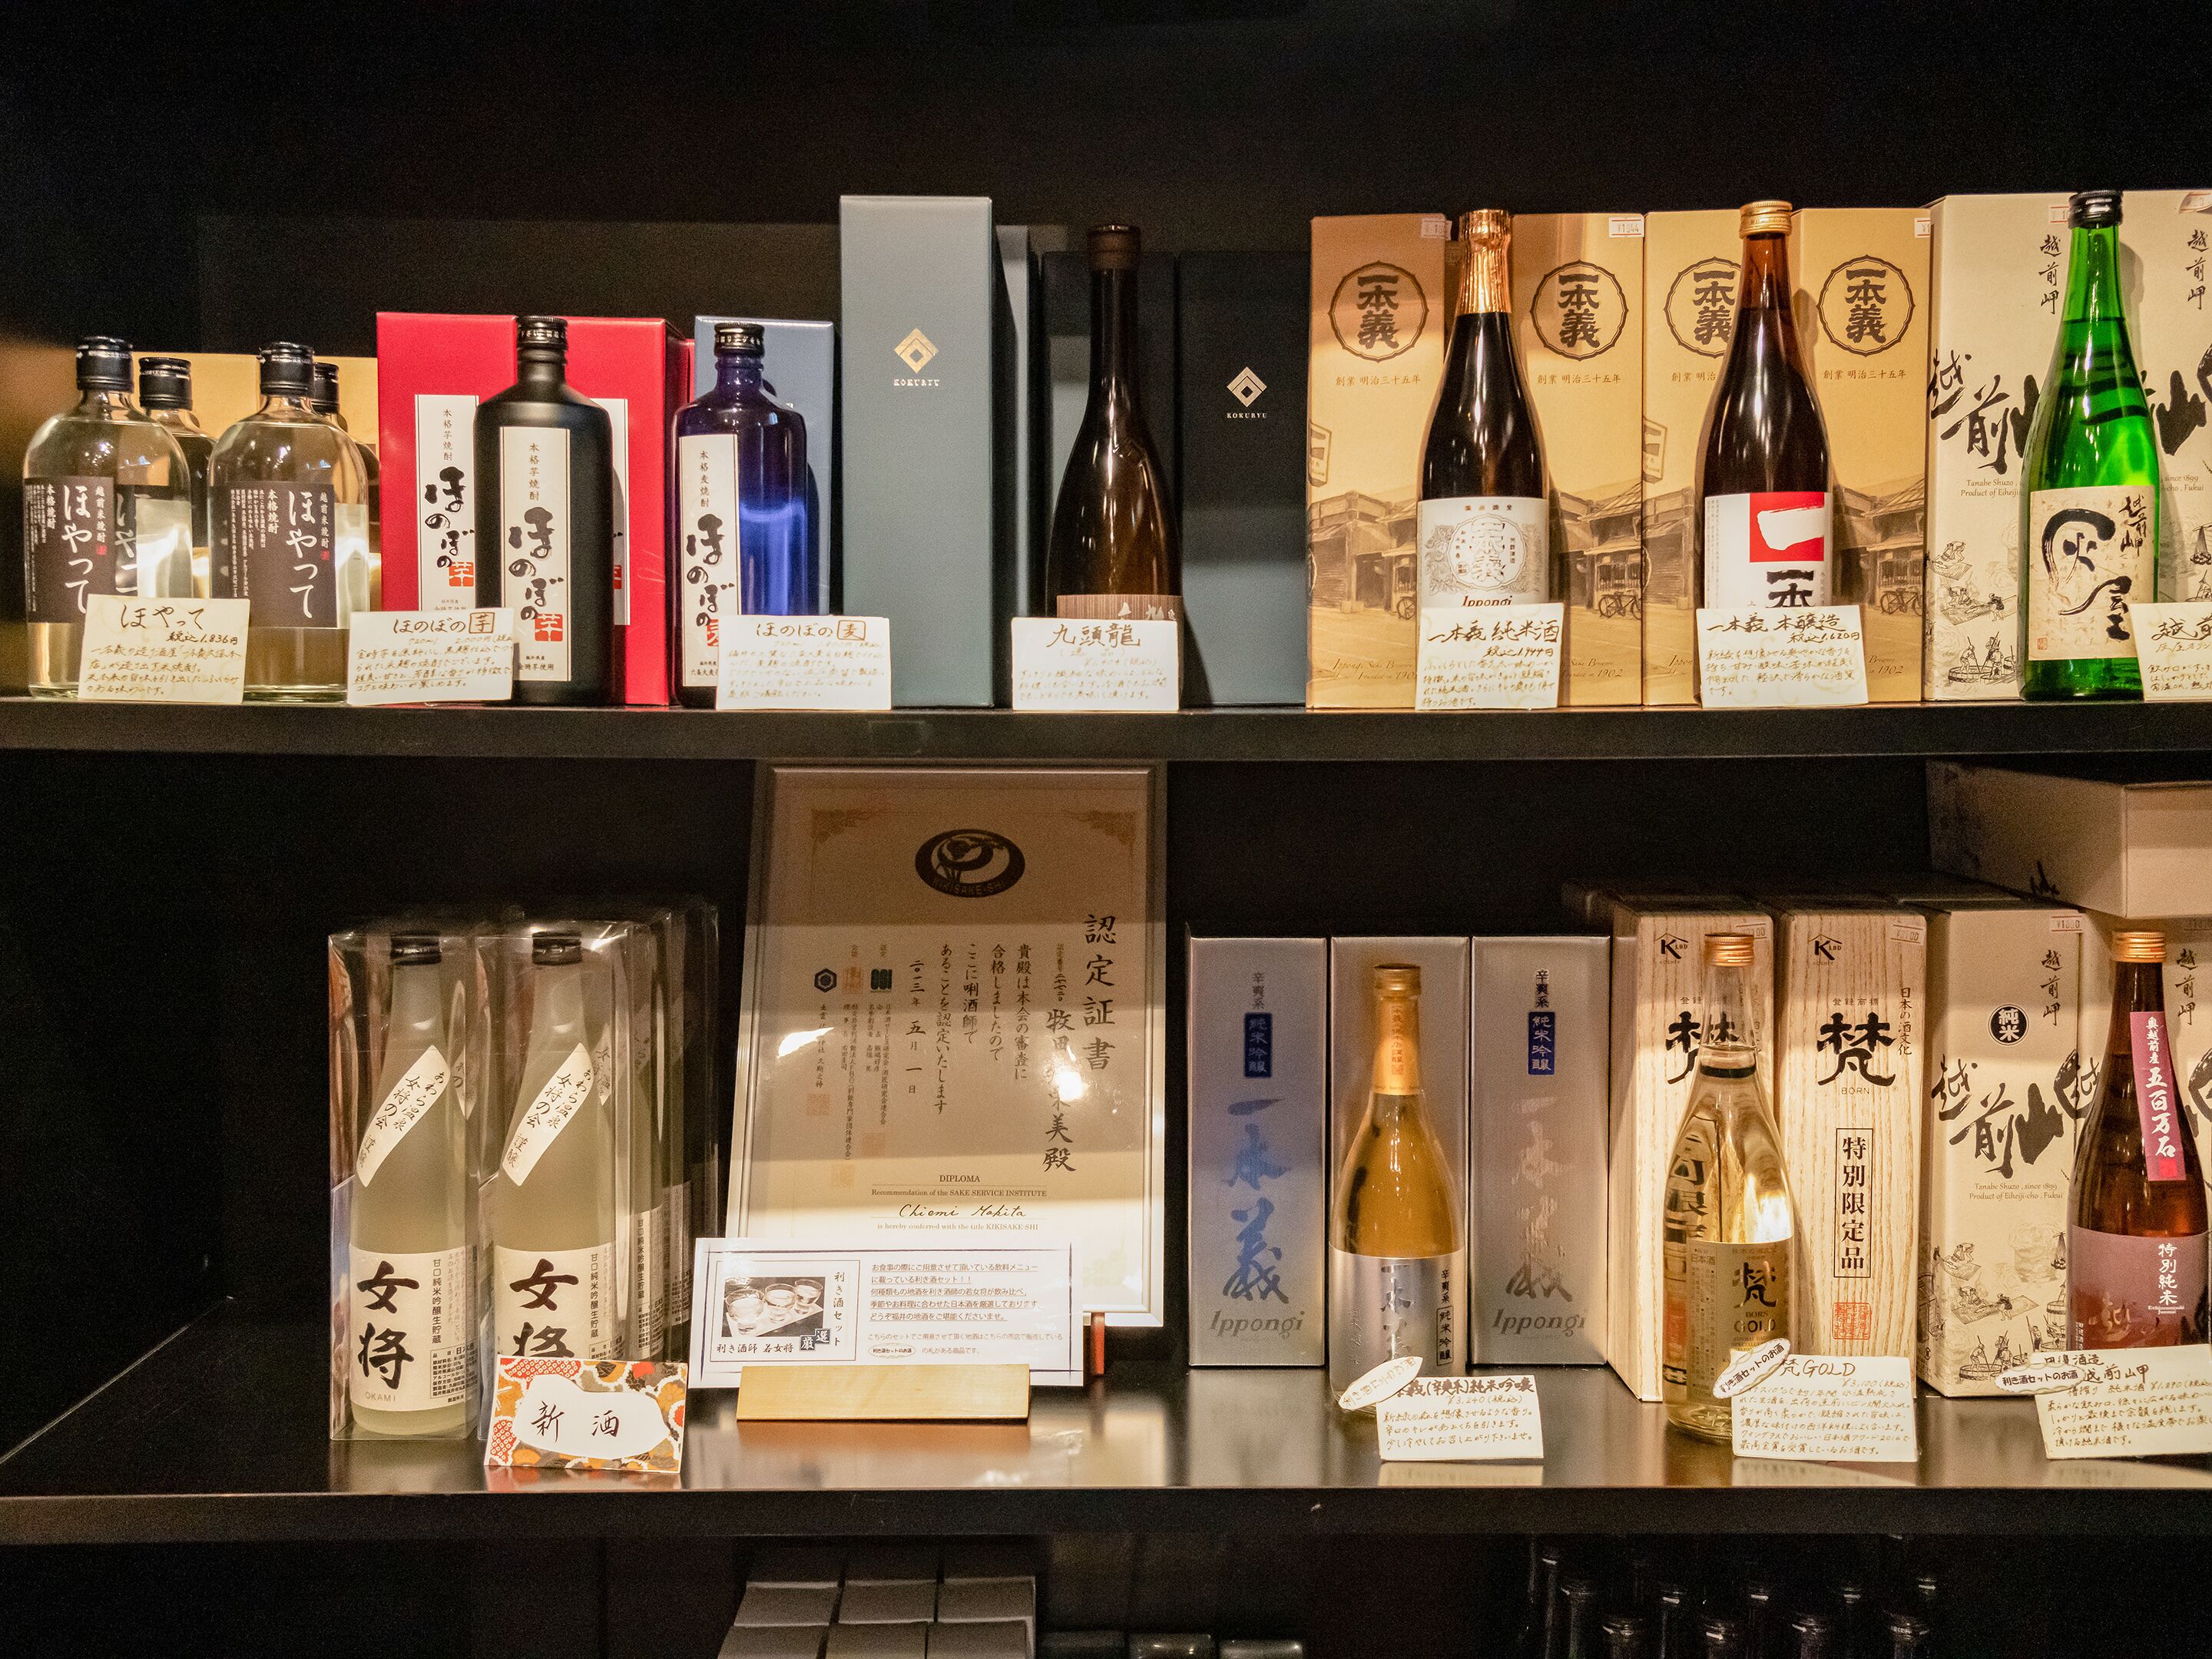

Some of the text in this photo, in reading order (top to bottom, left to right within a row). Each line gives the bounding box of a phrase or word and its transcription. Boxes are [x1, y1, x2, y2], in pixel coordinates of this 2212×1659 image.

[2038, 234, 2061, 314] 越前岬
[2186, 230, 2208, 310] 越前岬
[1357, 275, 1399, 349] 一本義
[1558, 273, 1600, 348] 一本義
[1694, 270, 1734, 345] 一本義
[1845, 269, 1886, 343] 一本義
[1538, 374, 1621, 384] 創業 明治三十五年
[1823, 369, 1906, 379] 創業 明治三十五年
[528, 443, 539, 501] 本格芋焼酎
[425, 466, 475, 568] ほのぼの
[62, 485, 93, 614] ほやって
[286, 491, 318, 618] ほやって
[508, 507, 565, 621] ほのぼの
[687, 513, 735, 627] ほのぼの
[121, 604, 204, 630] ほやって
[393, 618, 465, 634] ほのぼの
[756, 622, 833, 637] ほのぼの
[1046, 623, 1141, 648] 九頭龍
[1427, 620, 1560, 643] 一本義 純米酒
[1707, 612, 1846, 633] 一本義 本醸造
[1598, 669, 1623, 677] 1902
[1879, 665, 1903, 674] 1902
[988, 943, 1005, 1061] 合格しましたので
[1015, 943, 1031, 1080] 貴殿は本会の審査に
[1083, 914, 1117, 1071] 認定証書
[2039, 949, 2064, 1026] 越前岬
[2175, 949, 2197, 1026] 越前岬
[934, 944, 952, 1114] あることを認定いたします
[1817, 1012, 1897, 1086] 梵
[1897, 987, 1912, 1056] 日本の酒文化
[1998, 1008, 2020, 1041] 純米
[376, 1076, 420, 1130] 女将の会
[393, 1071, 444, 1131] あわら温泉
[526, 1074, 572, 1128] 女将の会
[547, 1069, 591, 1129] あわら温泉
[1841, 1087, 1870, 1095] BORN
[2144, 1016, 2177, 1158] 奥越前産 五百万石
[1840, 1137, 1867, 1270] 特別限定品
[2005, 1191, 2038, 1200] Eiheiji-cho
[2042, 1183, 2058, 1191] 1899
[432, 1259, 442, 1344] 甘口純米吟醸生貯蔵
[2157, 1242, 2178, 1306] 特別純米
[356, 1260, 419, 1389] 女将
[833, 1271, 845, 1346] 利き酒セット
[1209, 1310, 1305, 1339] Ippongi
[1492, 1309, 1588, 1338] Ippongi
[1734, 1318, 1777, 1333] GOLD
[716, 1343, 794, 1353] 利き酒師 若女将
[1802, 1359, 1856, 1378] GOLD
[2002, 1369, 2079, 1386] 利き酒セットのお酒
[365, 1391, 396, 1402] OKAMI
[531, 1401, 619, 1442] 新酒
